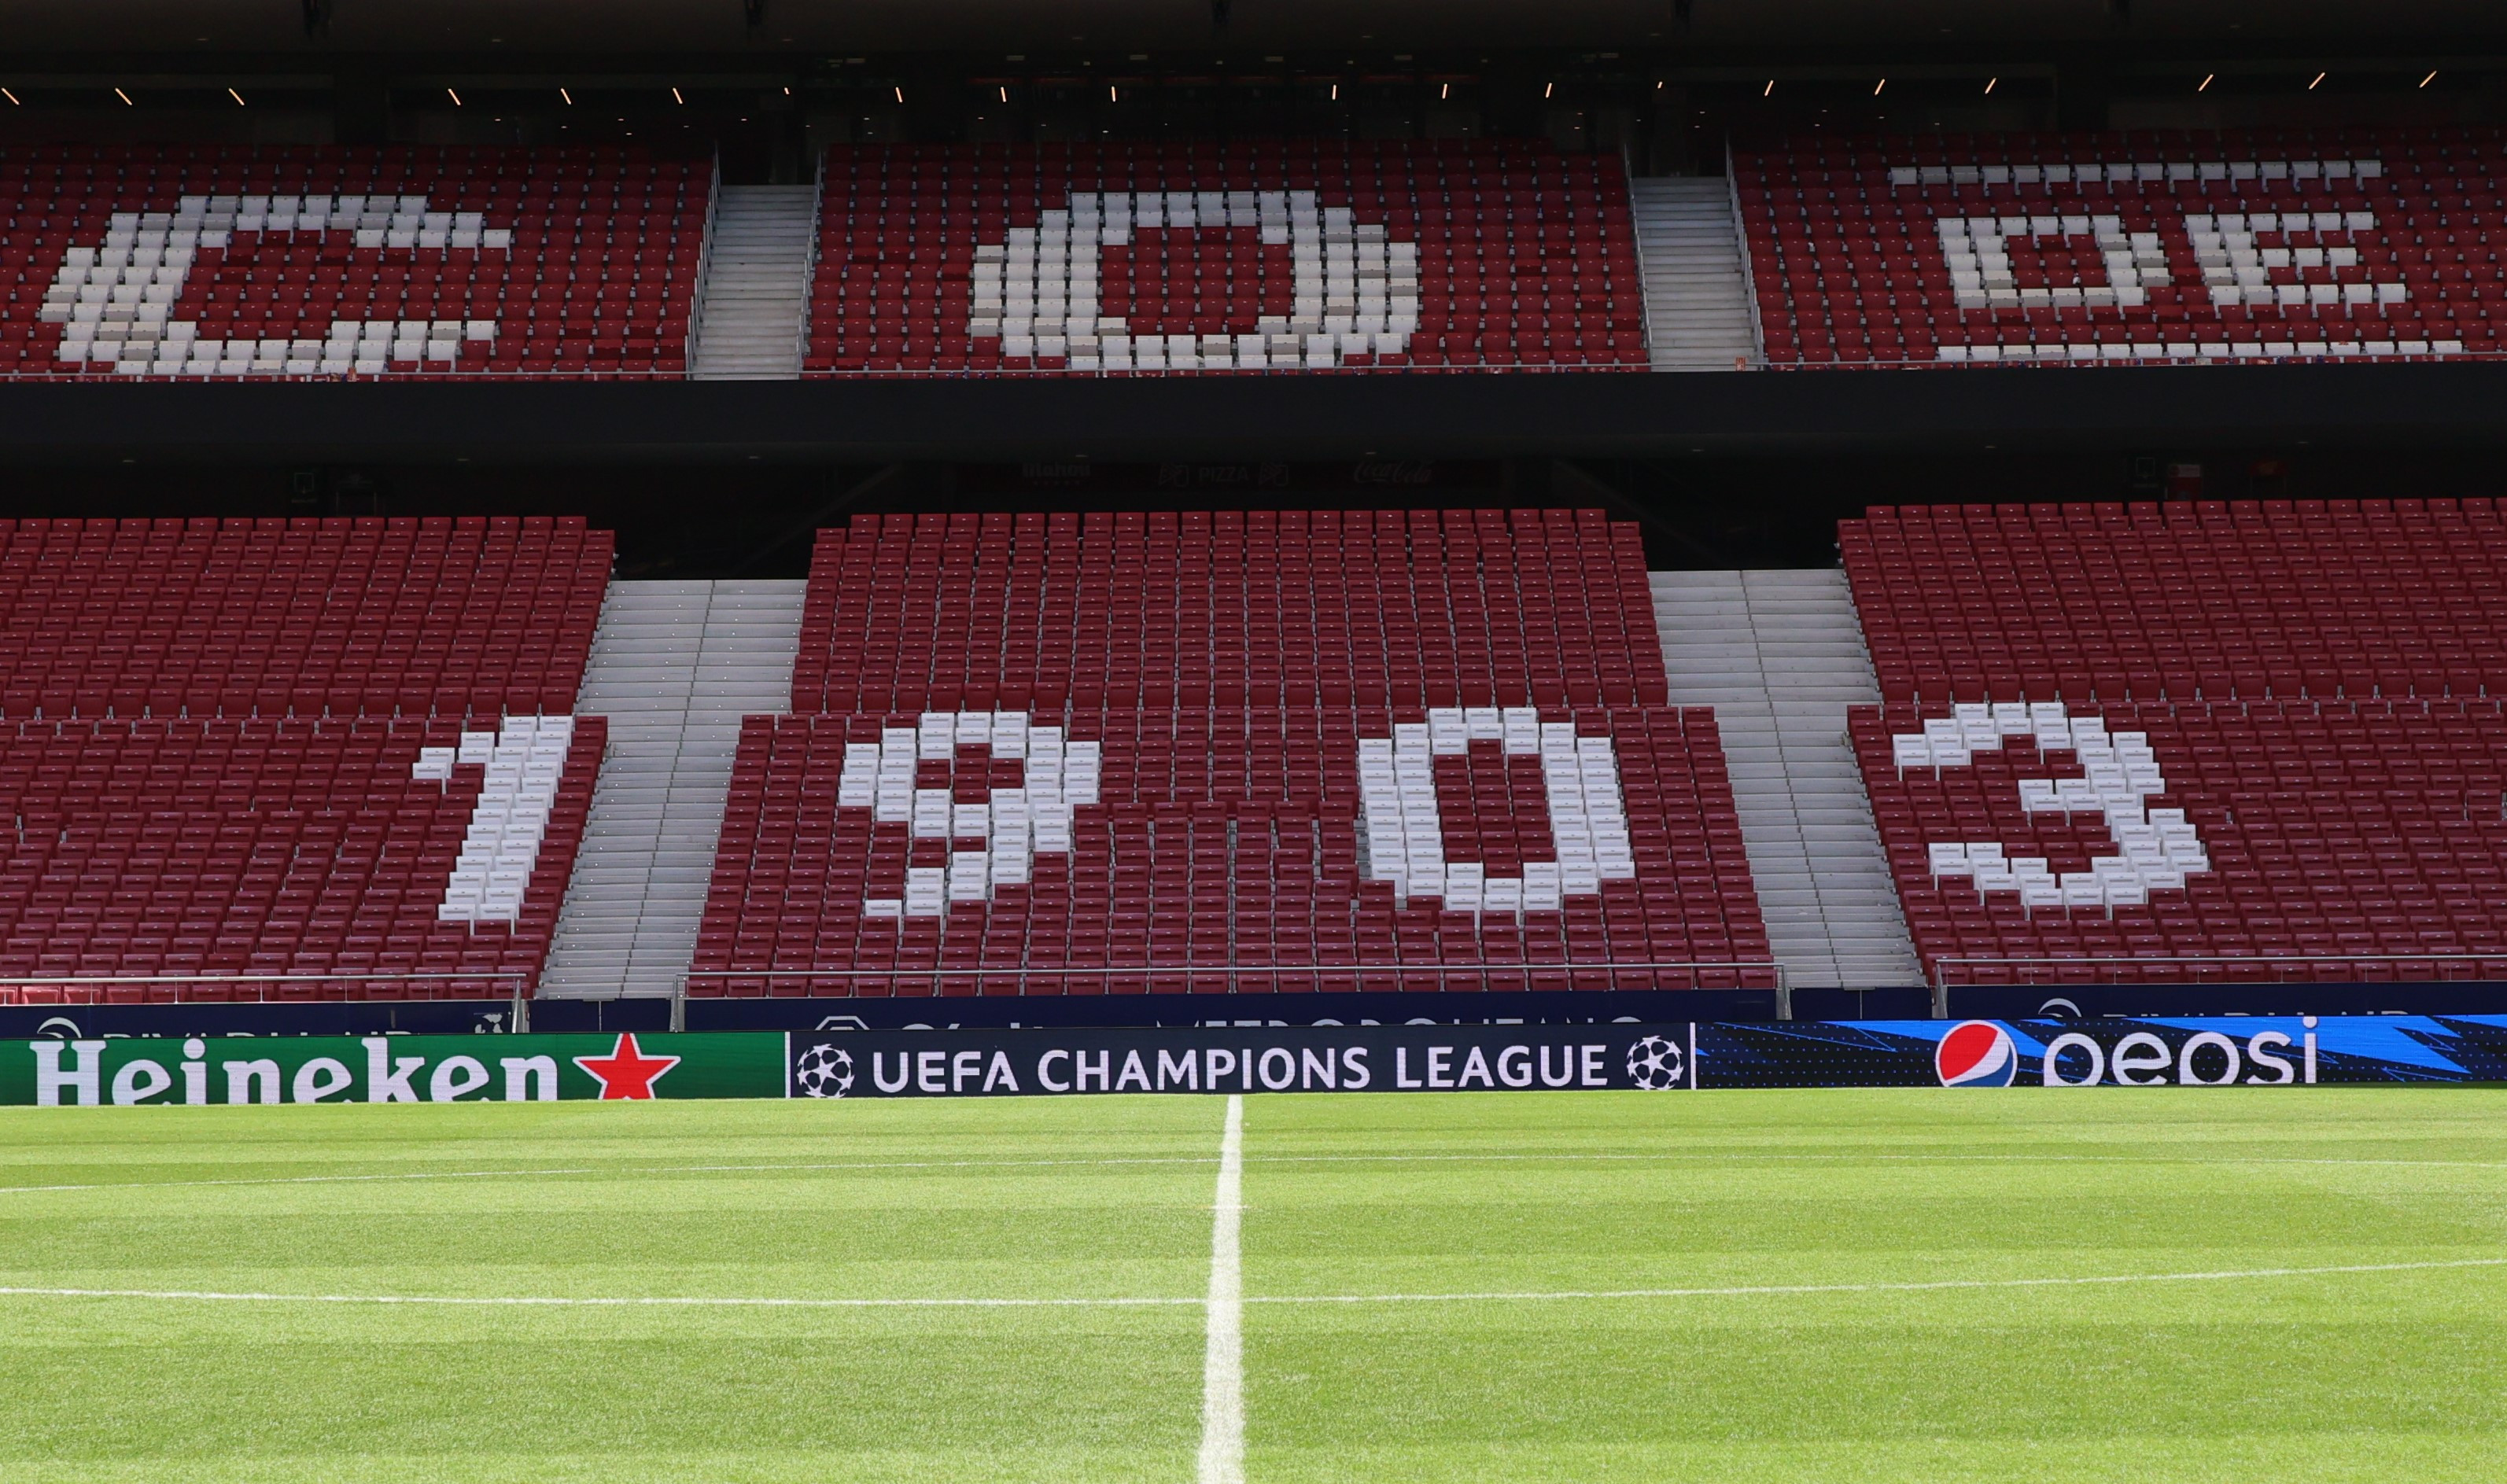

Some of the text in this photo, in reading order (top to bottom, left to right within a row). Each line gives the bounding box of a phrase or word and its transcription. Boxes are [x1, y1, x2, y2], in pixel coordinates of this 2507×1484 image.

[1199, 466, 1249, 482] PIZZA
[29, 1037, 559, 1106] Heineken
[873, 1044, 1609, 1093] UEFA CHAMPIONS LEAGUE
[2043, 1016, 2317, 1087] pepsi
